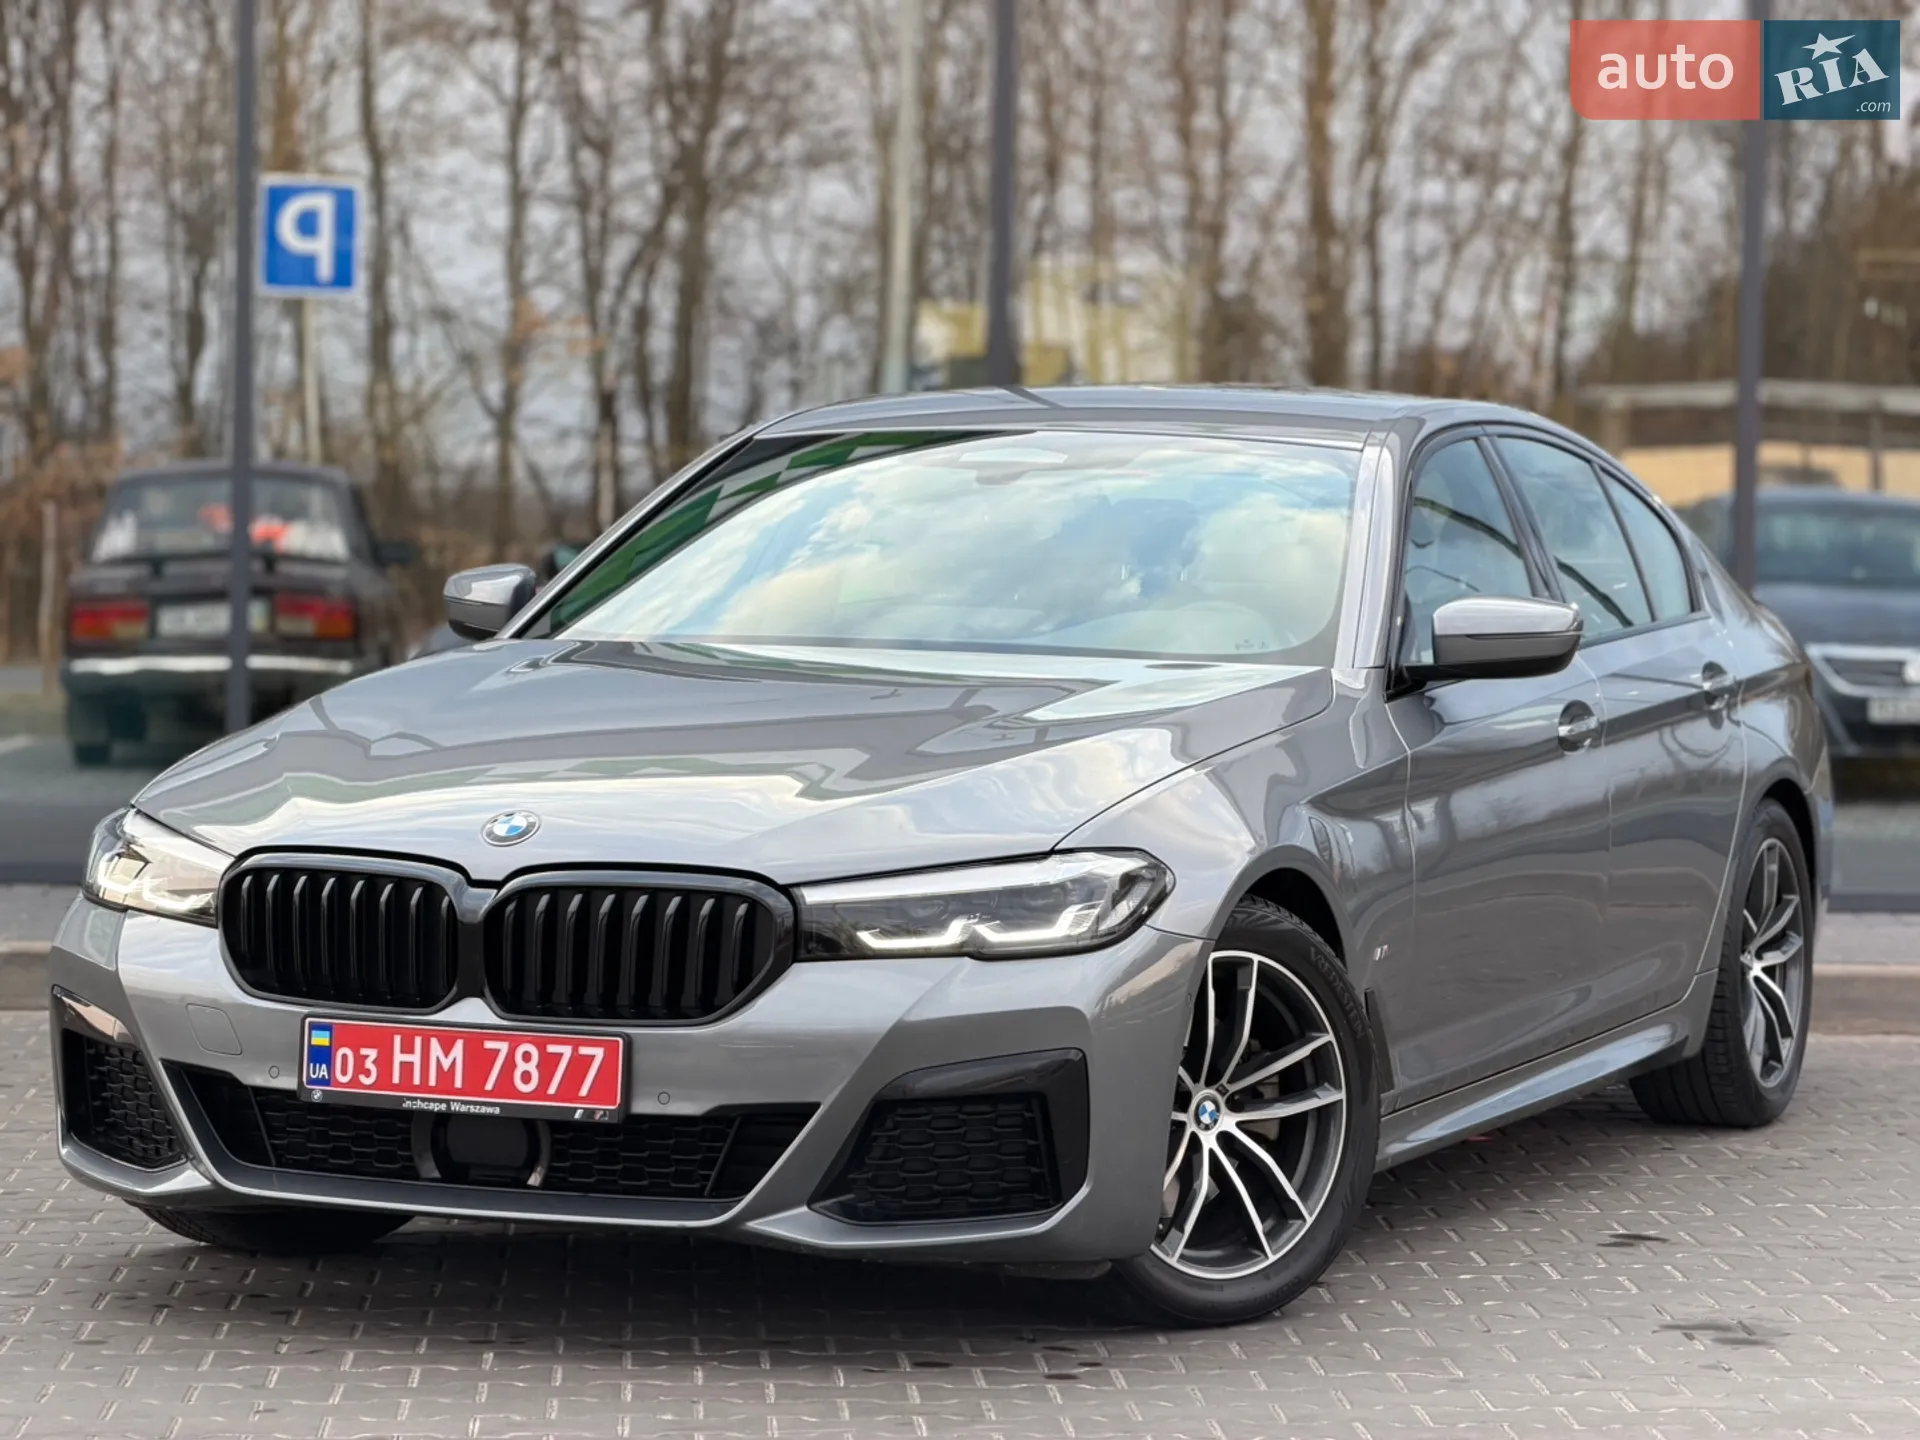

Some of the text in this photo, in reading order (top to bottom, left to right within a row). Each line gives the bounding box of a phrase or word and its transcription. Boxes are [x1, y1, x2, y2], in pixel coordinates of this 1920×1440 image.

[309, 1062, 329, 1079] UA
[335, 1034, 605, 1097] 03 HM 7877
[450, 1101, 500, 1115] Warszawa
